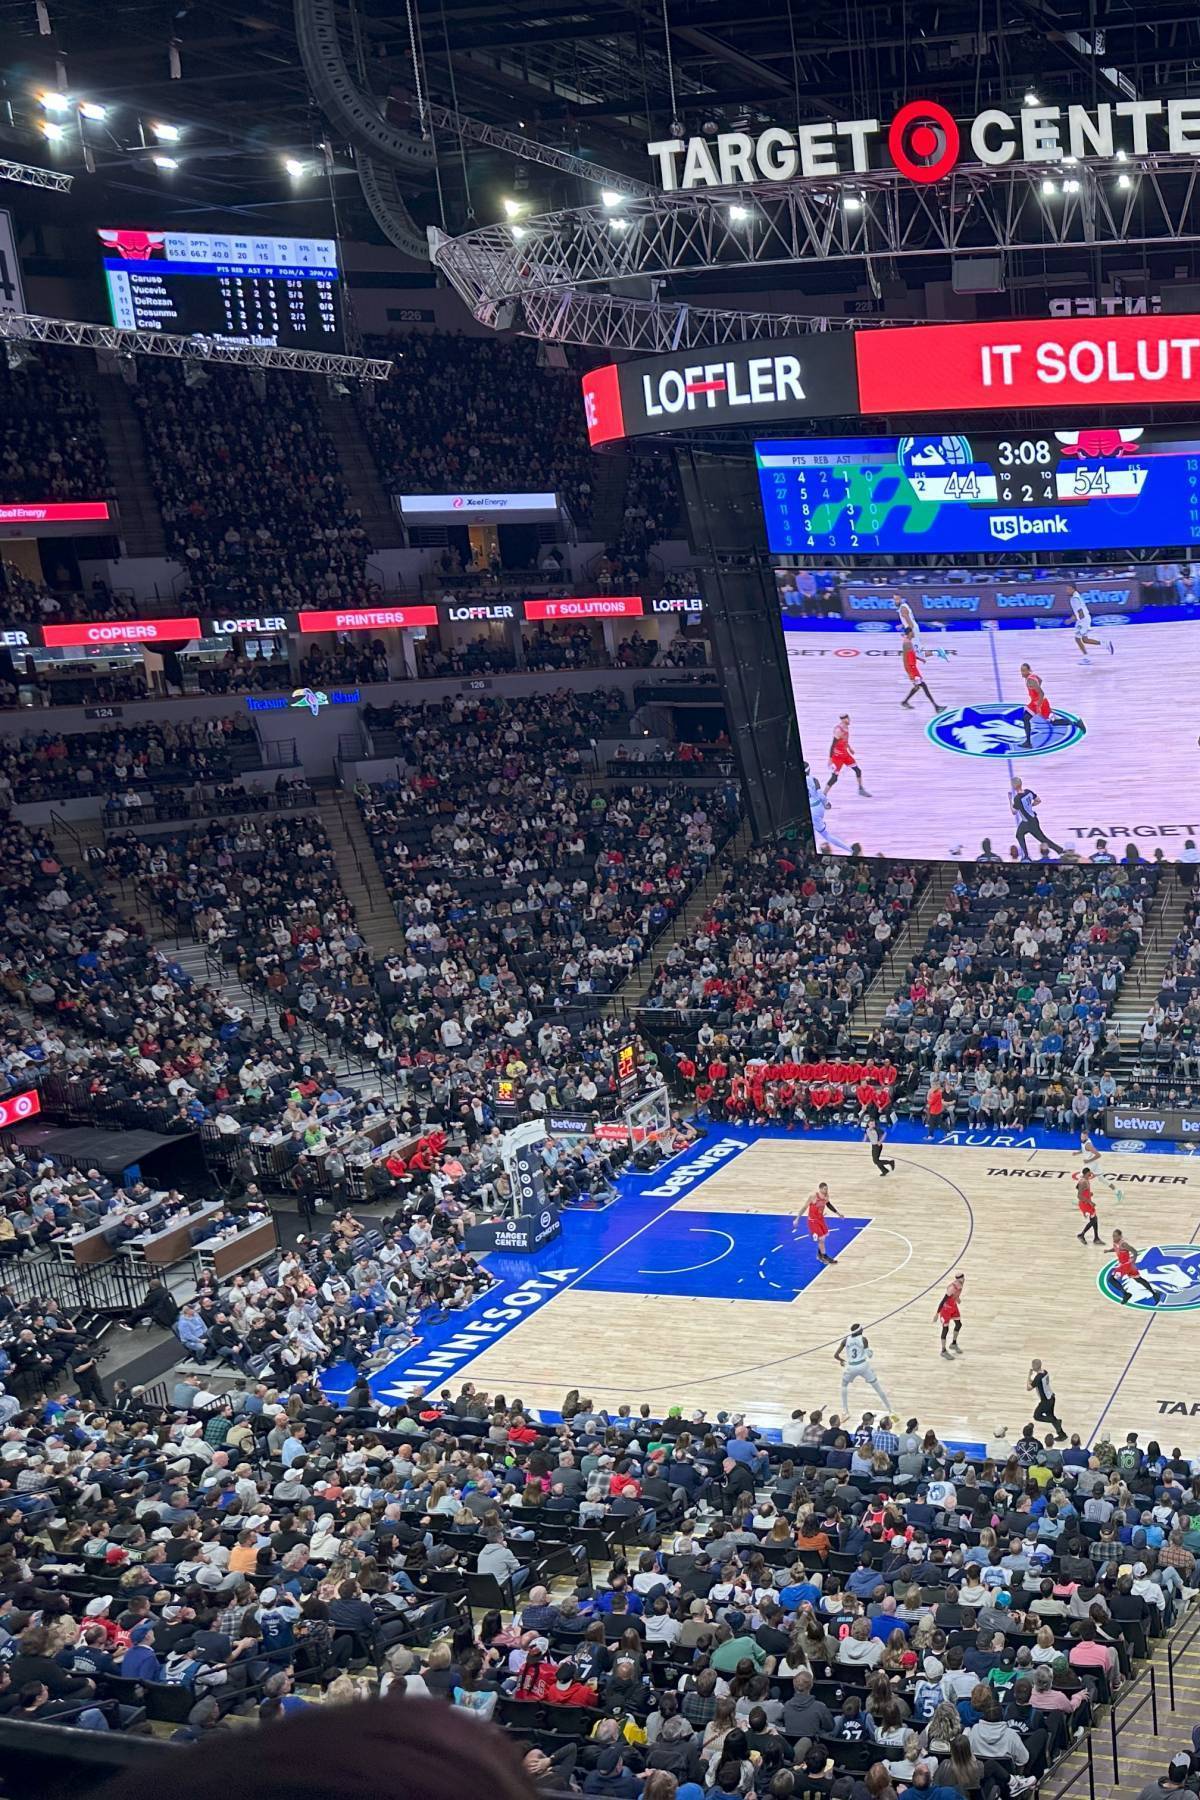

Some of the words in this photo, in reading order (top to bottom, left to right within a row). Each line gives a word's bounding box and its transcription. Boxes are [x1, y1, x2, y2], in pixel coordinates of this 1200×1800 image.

[648, 119, 882, 192] TARGET
[131, 274, 163, 284] Caruso
[980, 344, 1022, 387] IT
[643, 355, 807, 416] LOFFLER
[792, 456, 807, 465] PTS
[813, 456, 829, 465] REB
[836, 455, 852, 464] AST
[998, 440, 1051, 466] 3:08
[798, 472, 806, 483] 4
[1000, 472, 1011, 481] TO
[1040, 471, 1052, 480] TO
[1074, 466, 1110, 496] 54
[917, 480, 926, 492] 2
[944, 471, 980, 499] 44
[800, 488, 808, 500] 5
[1002, 487, 1012, 501] 6
[1021, 485, 1033, 502] 2
[1043, 487, 1053, 500] 4
[802, 504, 810, 516] 8
[846, 503, 854, 515] 3
[804, 520, 812, 532] 3
[807, 535, 815, 547] 4
[850, 535, 859, 547] 2
[545, 604, 557, 616] IT
[559, 601, 627, 615] SOLUTIONS
[922, 594, 980, 612] betway
[996, 592, 1056, 610] betway
[336, 612, 405, 627] PRINTERS
[448, 604, 514, 621] LOFFLER
[88, 625, 157, 641] COPIERS
[213, 616, 288, 635] LOFFLER
[470, 680, 485, 689] 126
[94, 707, 113, 718] 124
[1067, 824, 1200, 839] TARGET
[550, 1118, 588, 1132] betway
[1114, 1115, 1165, 1134] betway
[640, 1138, 749, 1197] betway
[986, 1168, 1071, 1180] TARGET
[1101, 1172, 1190, 1185] CENTER
[495, 1231, 528, 1240] TARGET
[495, 1239, 528, 1247] CENTER
[377, 1268, 580, 1400] MINNESOTA
[854, 1435, 869, 1448] 27
[268, 1625, 279, 1636] 5
[579, 1663, 592, 1679] 7
[922, 1700, 935, 1718] 5
